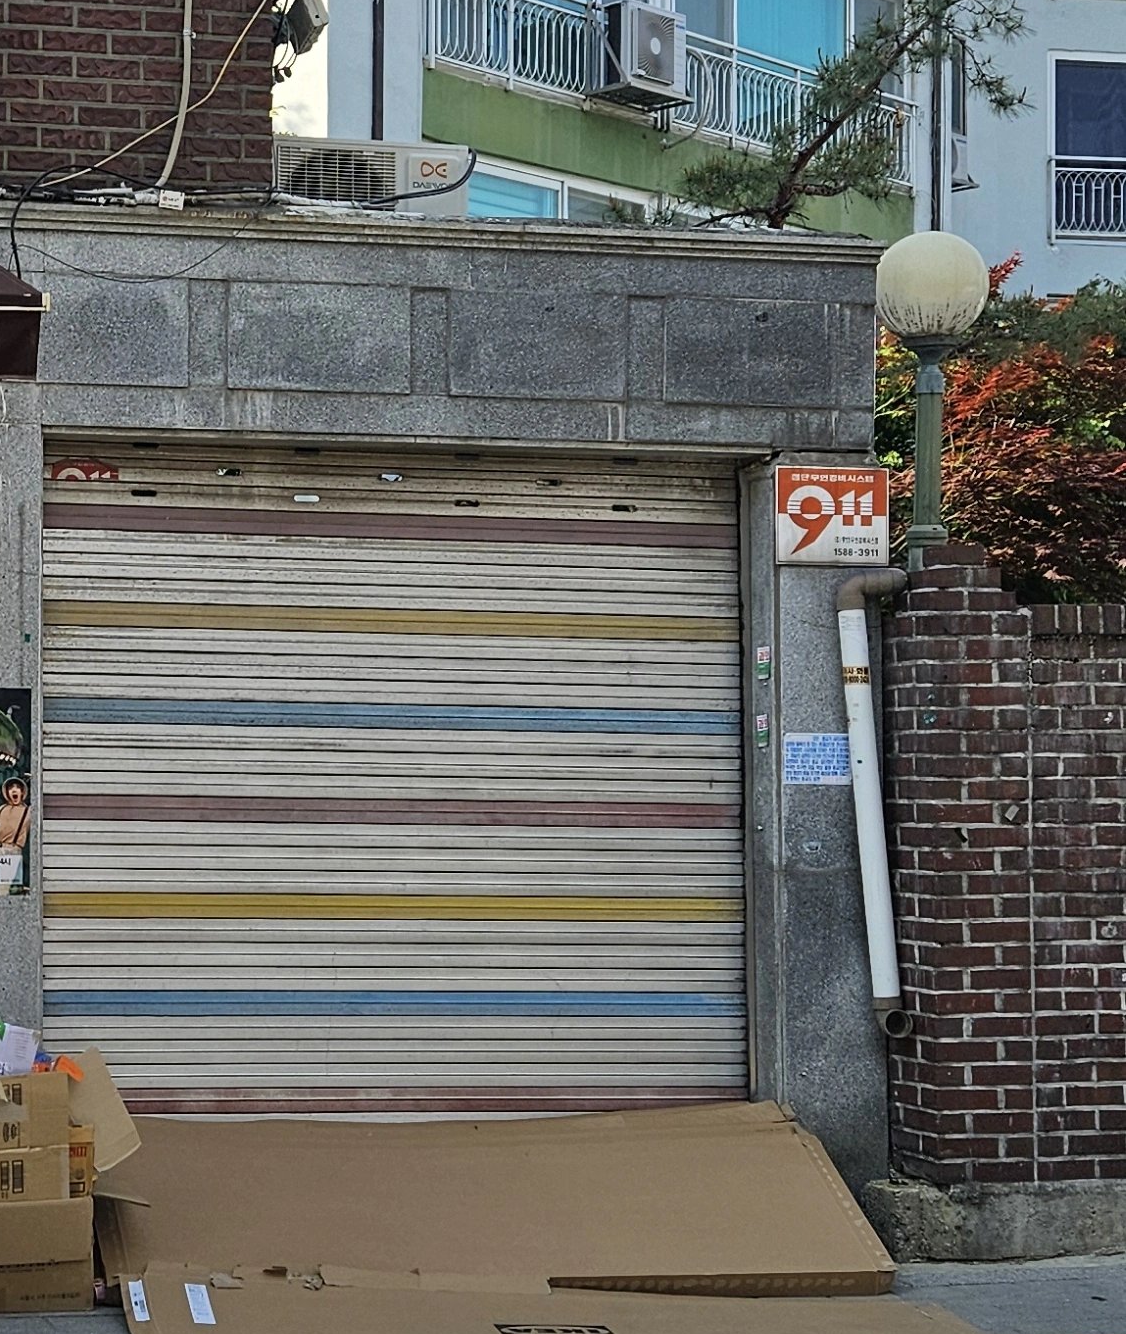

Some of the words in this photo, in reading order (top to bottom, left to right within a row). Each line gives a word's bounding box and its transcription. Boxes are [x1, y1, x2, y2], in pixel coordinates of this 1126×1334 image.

[412, 181, 455, 190] DAEWO
[786, 485, 873, 556] 911
[833, 547, 879, 557] 1588-3911
